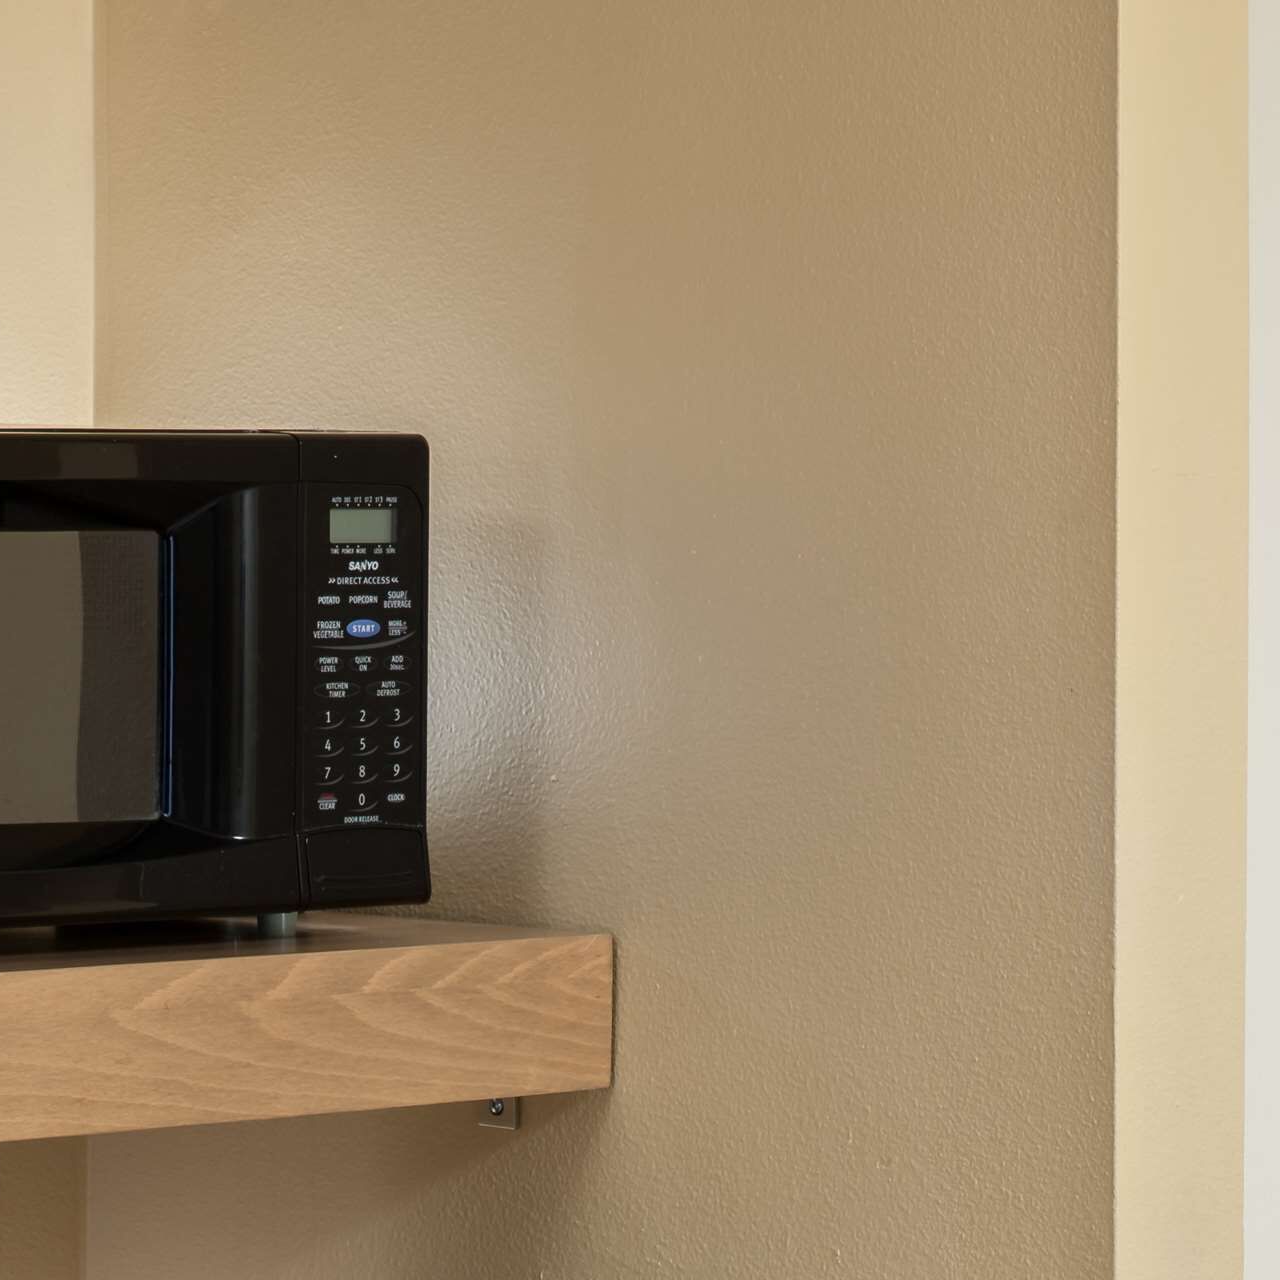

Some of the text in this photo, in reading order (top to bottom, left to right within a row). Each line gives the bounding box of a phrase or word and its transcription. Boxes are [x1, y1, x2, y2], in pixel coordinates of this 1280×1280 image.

[348, 560, 379, 572] SANYO
[336, 577, 390, 585] DIRECT ACCESS
[387, 591, 408, 600] SOUP/
[318, 596, 341, 605] POTATO
[348, 596, 378, 605] POPCORN
[384, 599, 412, 609] BEVERAGE
[317, 620, 341, 630] FROZEN
[352, 624, 375, 633] START
[313, 629, 345, 639] VEGETABLE
[319, 657, 338, 665] POWER
[354, 656, 372, 664] QUICK
[391, 655, 404, 663] ADD
[320, 665, 337, 673] LEVEL
[358, 664, 368, 672] ON
[326, 682, 349, 690] KITCHEN
[381, 681, 396, 689] AUTO
[329, 690, 346, 698] TIMER
[376, 688, 400, 697] DEFROST
[325, 711, 332, 723] 1
[359, 710, 367, 722] 2
[394, 709, 401, 721] 3
[324, 739, 331, 752] 4
[359, 738, 366, 750] 5
[393, 736, 401, 749] 6
[324, 767, 331, 779] 7
[358, 765, 366, 778] 8
[393, 764, 400, 776] 9
[358, 793, 366, 806] 0
[387, 793, 405, 802] CLOCK
[318, 802, 336, 811] CLEAR
[343, 816, 379, 824] DOOR RELEASE
